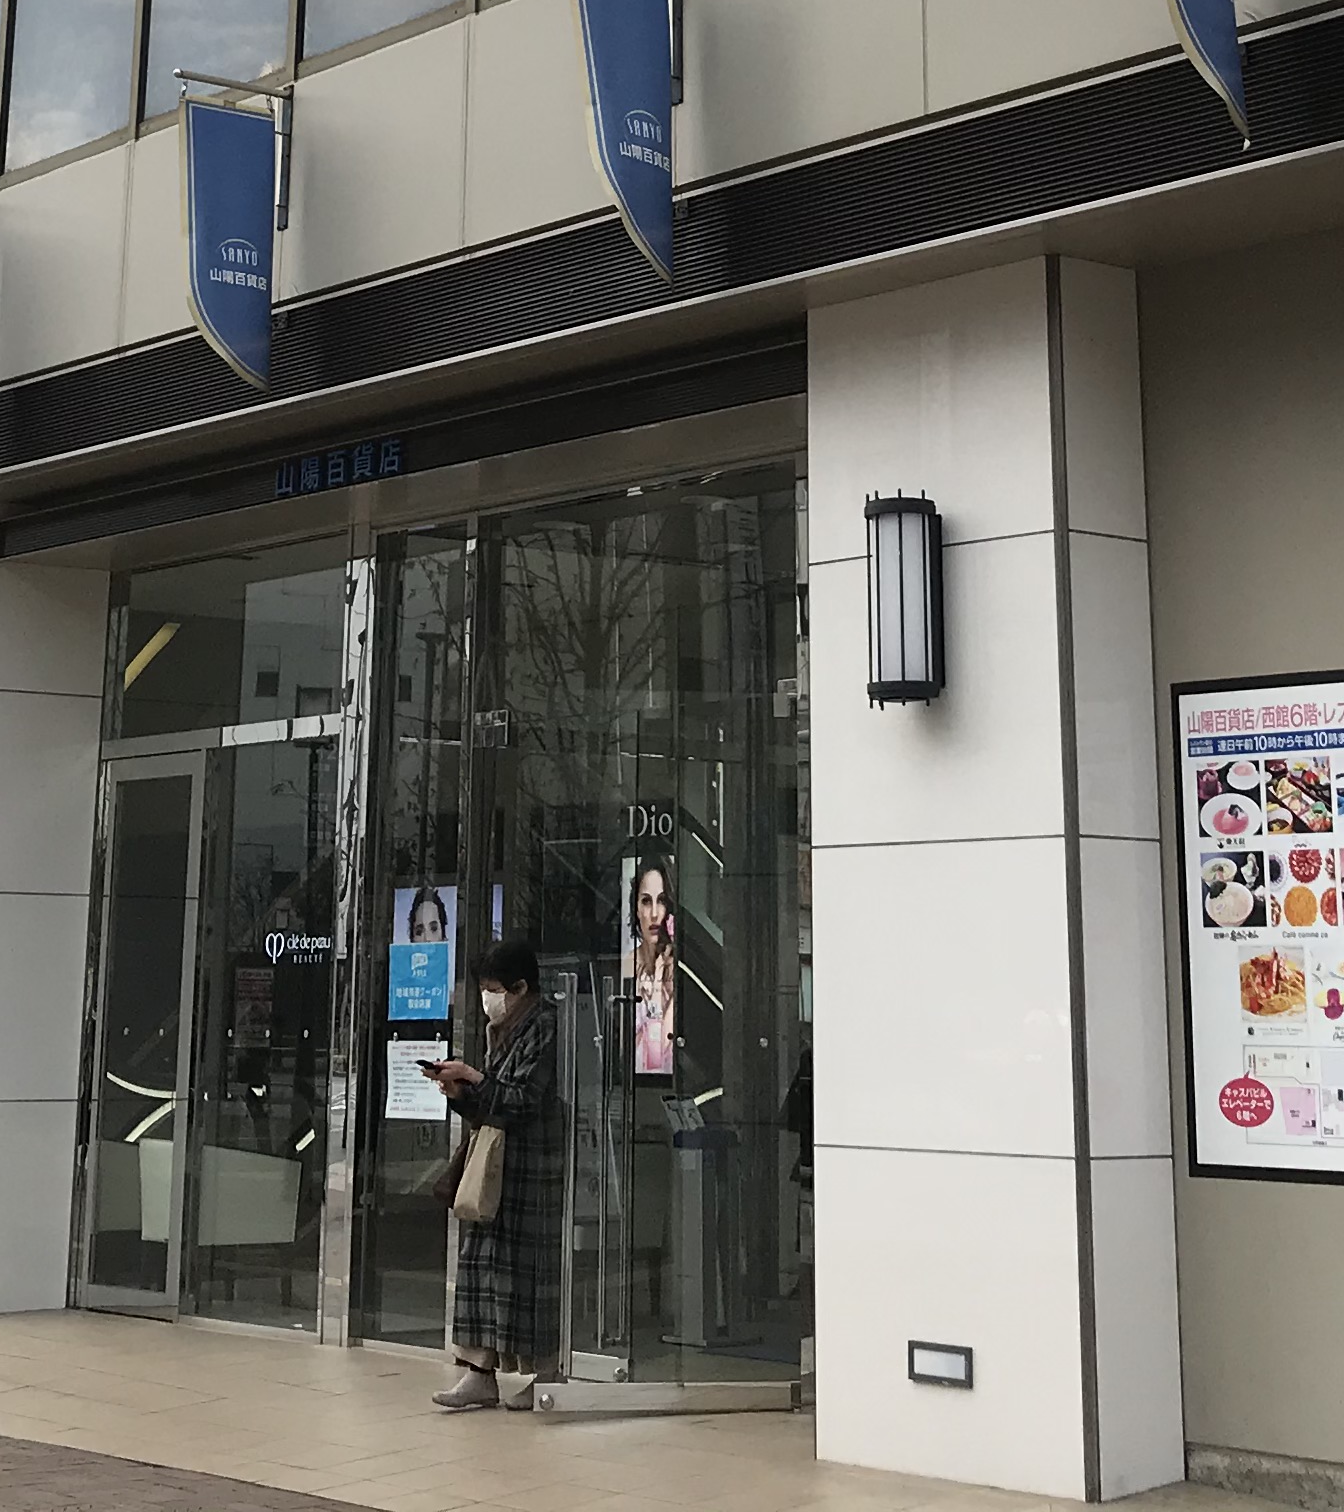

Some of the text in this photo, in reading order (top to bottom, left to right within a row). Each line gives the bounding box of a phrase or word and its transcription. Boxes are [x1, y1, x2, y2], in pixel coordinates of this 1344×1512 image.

[626, 115, 662, 143] SANYO
[619, 141, 671, 172] 山陽百貨店
[221, 244, 258, 267] SANYO
[209, 268, 267, 292] 山陽百貨店
[275, 439, 401, 498] 山陽百貨店
